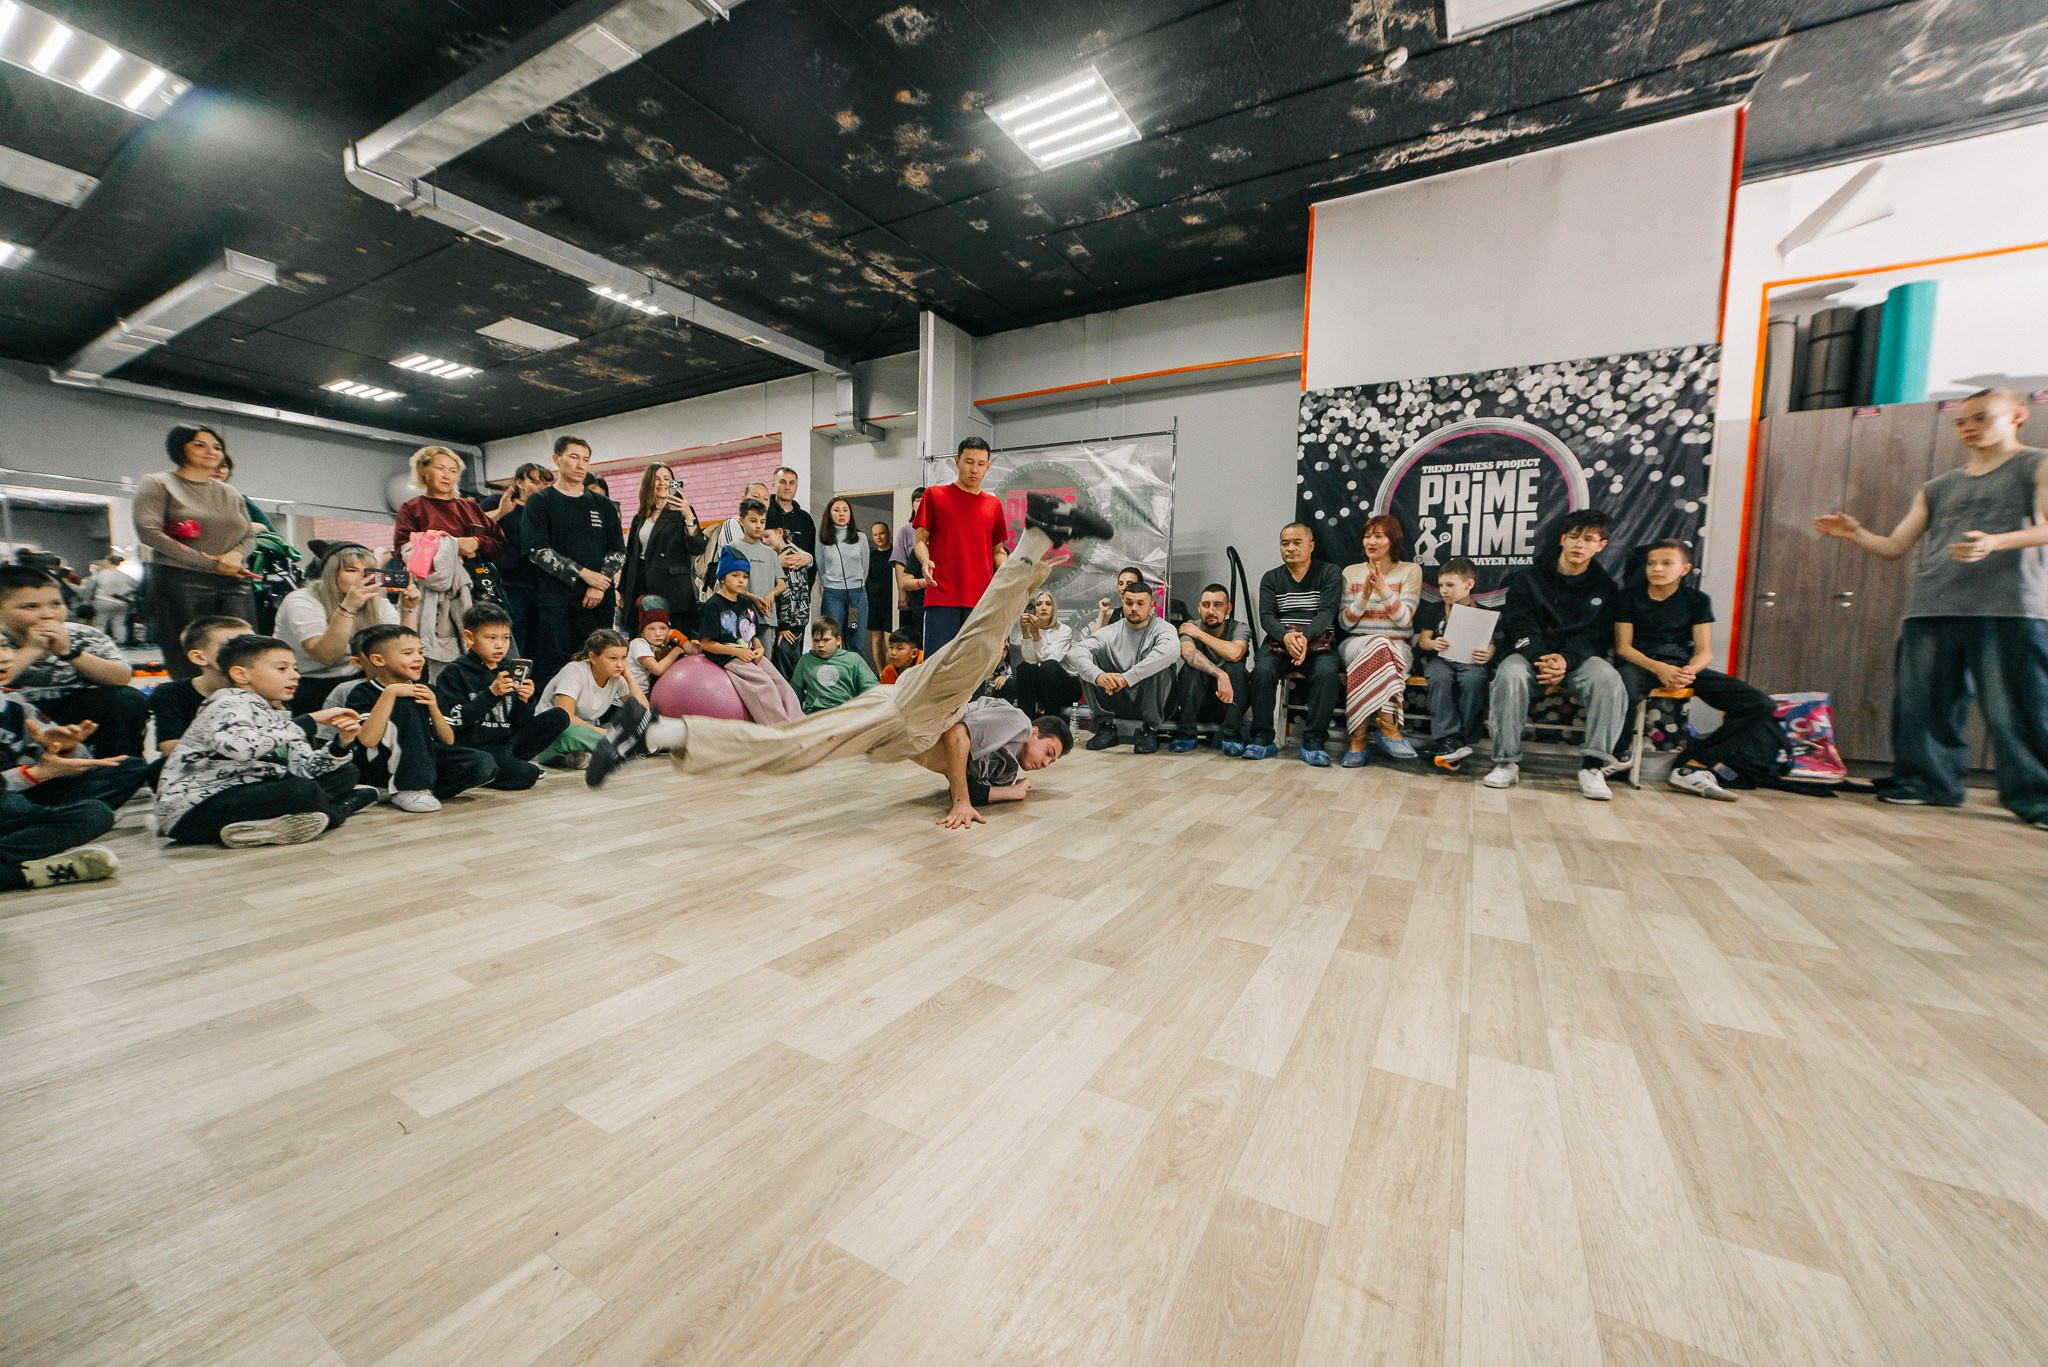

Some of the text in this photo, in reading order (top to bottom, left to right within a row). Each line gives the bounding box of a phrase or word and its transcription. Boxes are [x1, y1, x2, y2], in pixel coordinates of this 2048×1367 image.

[1422, 458, 1540, 474] TREND FITNESS PROJECT
[1447, 512, 1537, 556] TIME
[1508, 556, 1533, 565] N&A
